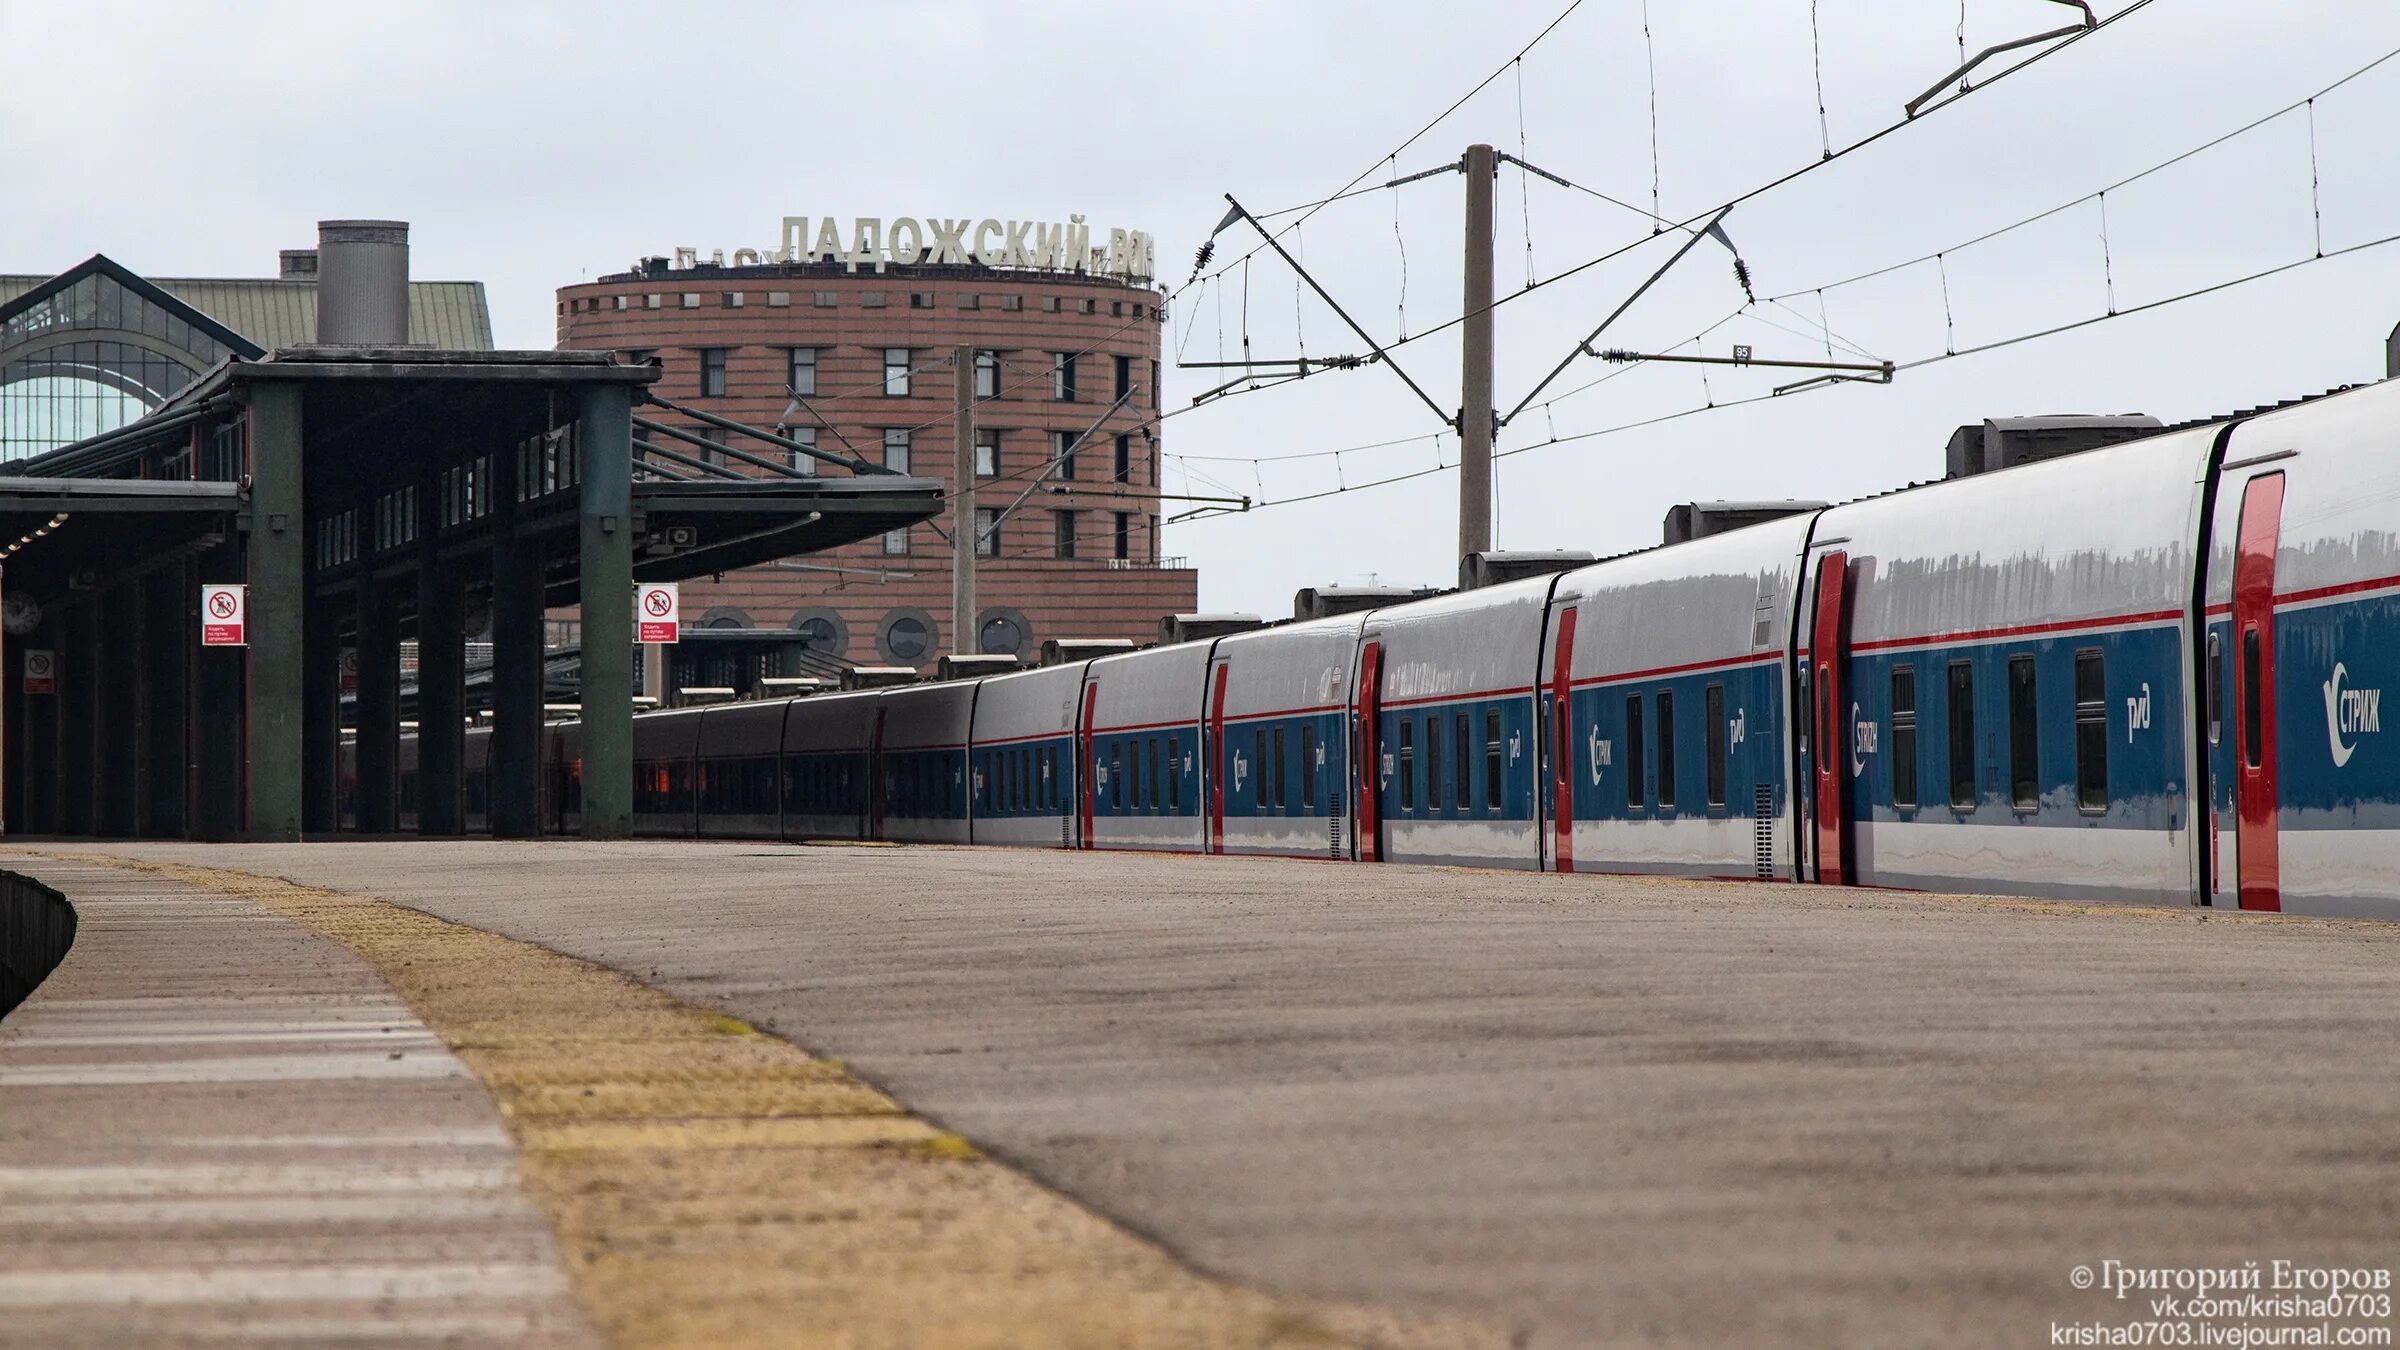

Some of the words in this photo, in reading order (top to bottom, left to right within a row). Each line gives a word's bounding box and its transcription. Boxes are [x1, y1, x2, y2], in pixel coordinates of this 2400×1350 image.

[775, 213, 1089, 274] ЛАДОЖСКИЙ
[1736, 346, 1748, 357] 95
[2341, 689, 2380, 733] СТРИЖ
[1857, 721, 1878, 753] STRIZH
